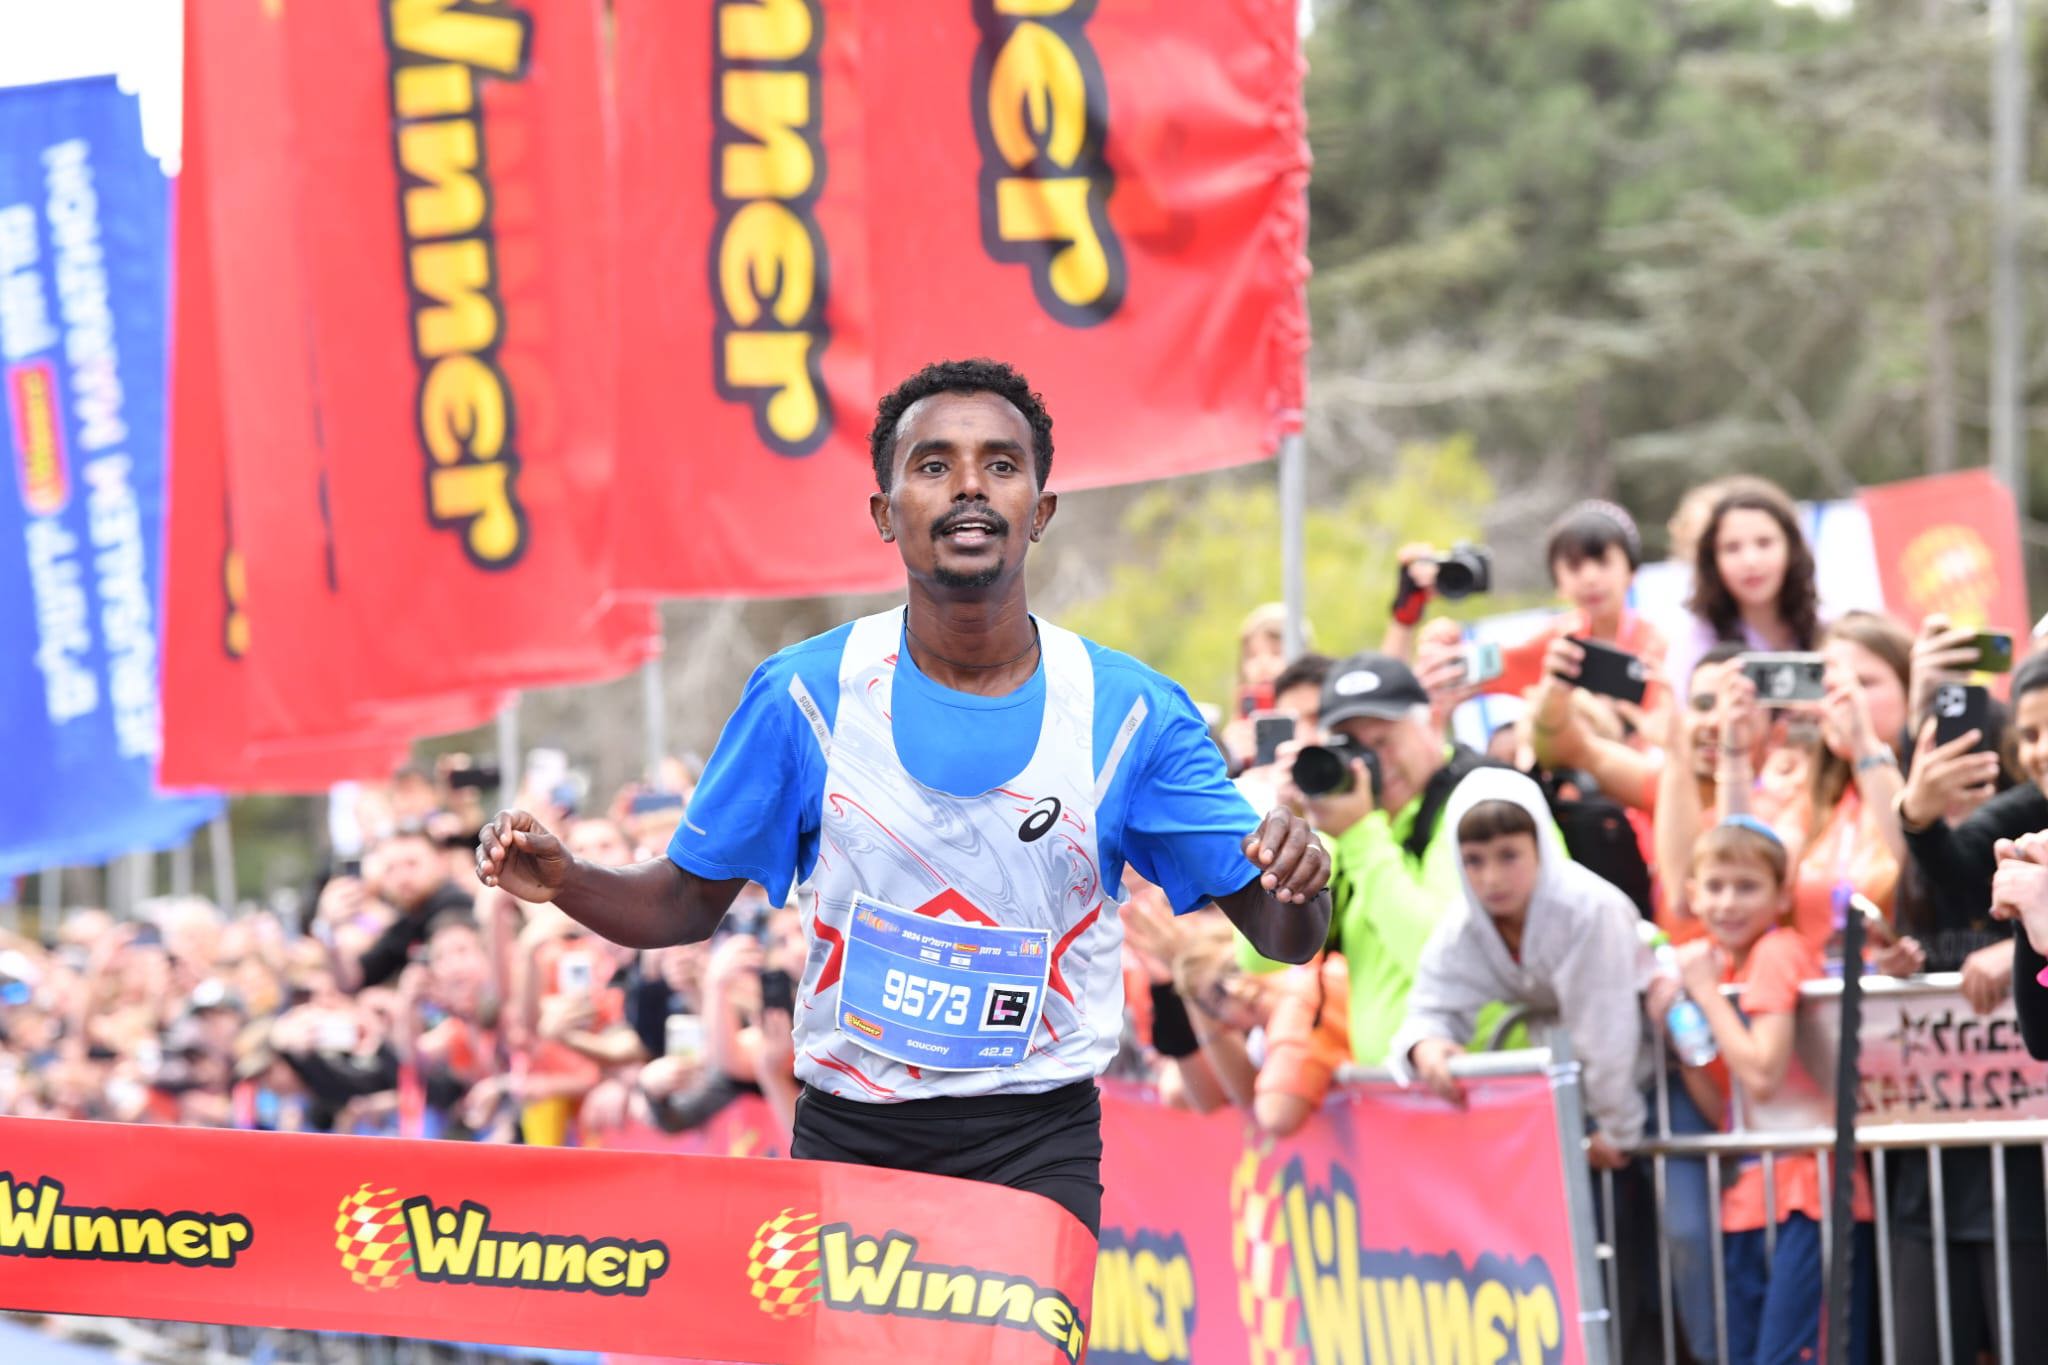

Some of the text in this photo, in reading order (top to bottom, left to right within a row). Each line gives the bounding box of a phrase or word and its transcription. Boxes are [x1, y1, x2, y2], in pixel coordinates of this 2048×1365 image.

[882, 967, 972, 1026] 9573
[906, 1038, 950, 1056] saucony
[978, 1046, 1014, 1058] 42.2
[0, 1177, 250, 1262] Winner
[405, 1202, 667, 1290] Winner
